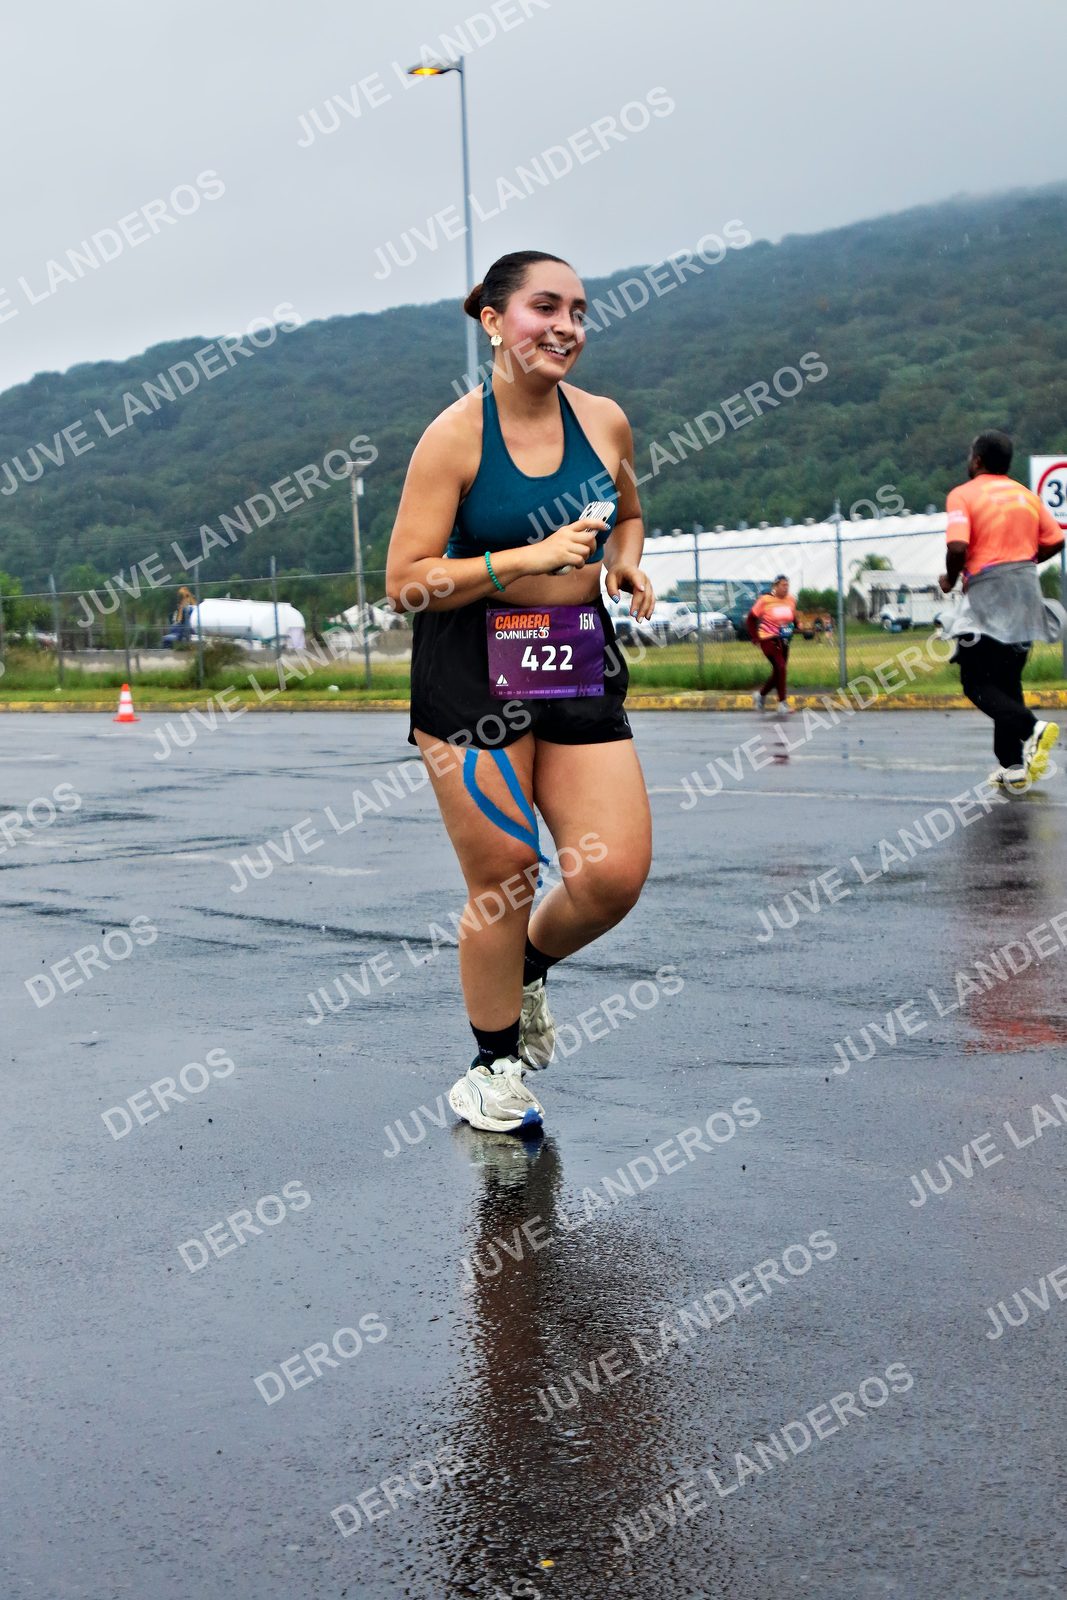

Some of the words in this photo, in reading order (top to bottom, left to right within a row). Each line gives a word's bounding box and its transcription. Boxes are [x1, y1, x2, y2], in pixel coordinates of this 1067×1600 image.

[1047, 480, 1067, 508] 3
[495, 614, 550, 630] CARRERA
[579, 613, 595, 630] 15K
[521, 645, 573, 671] 422
